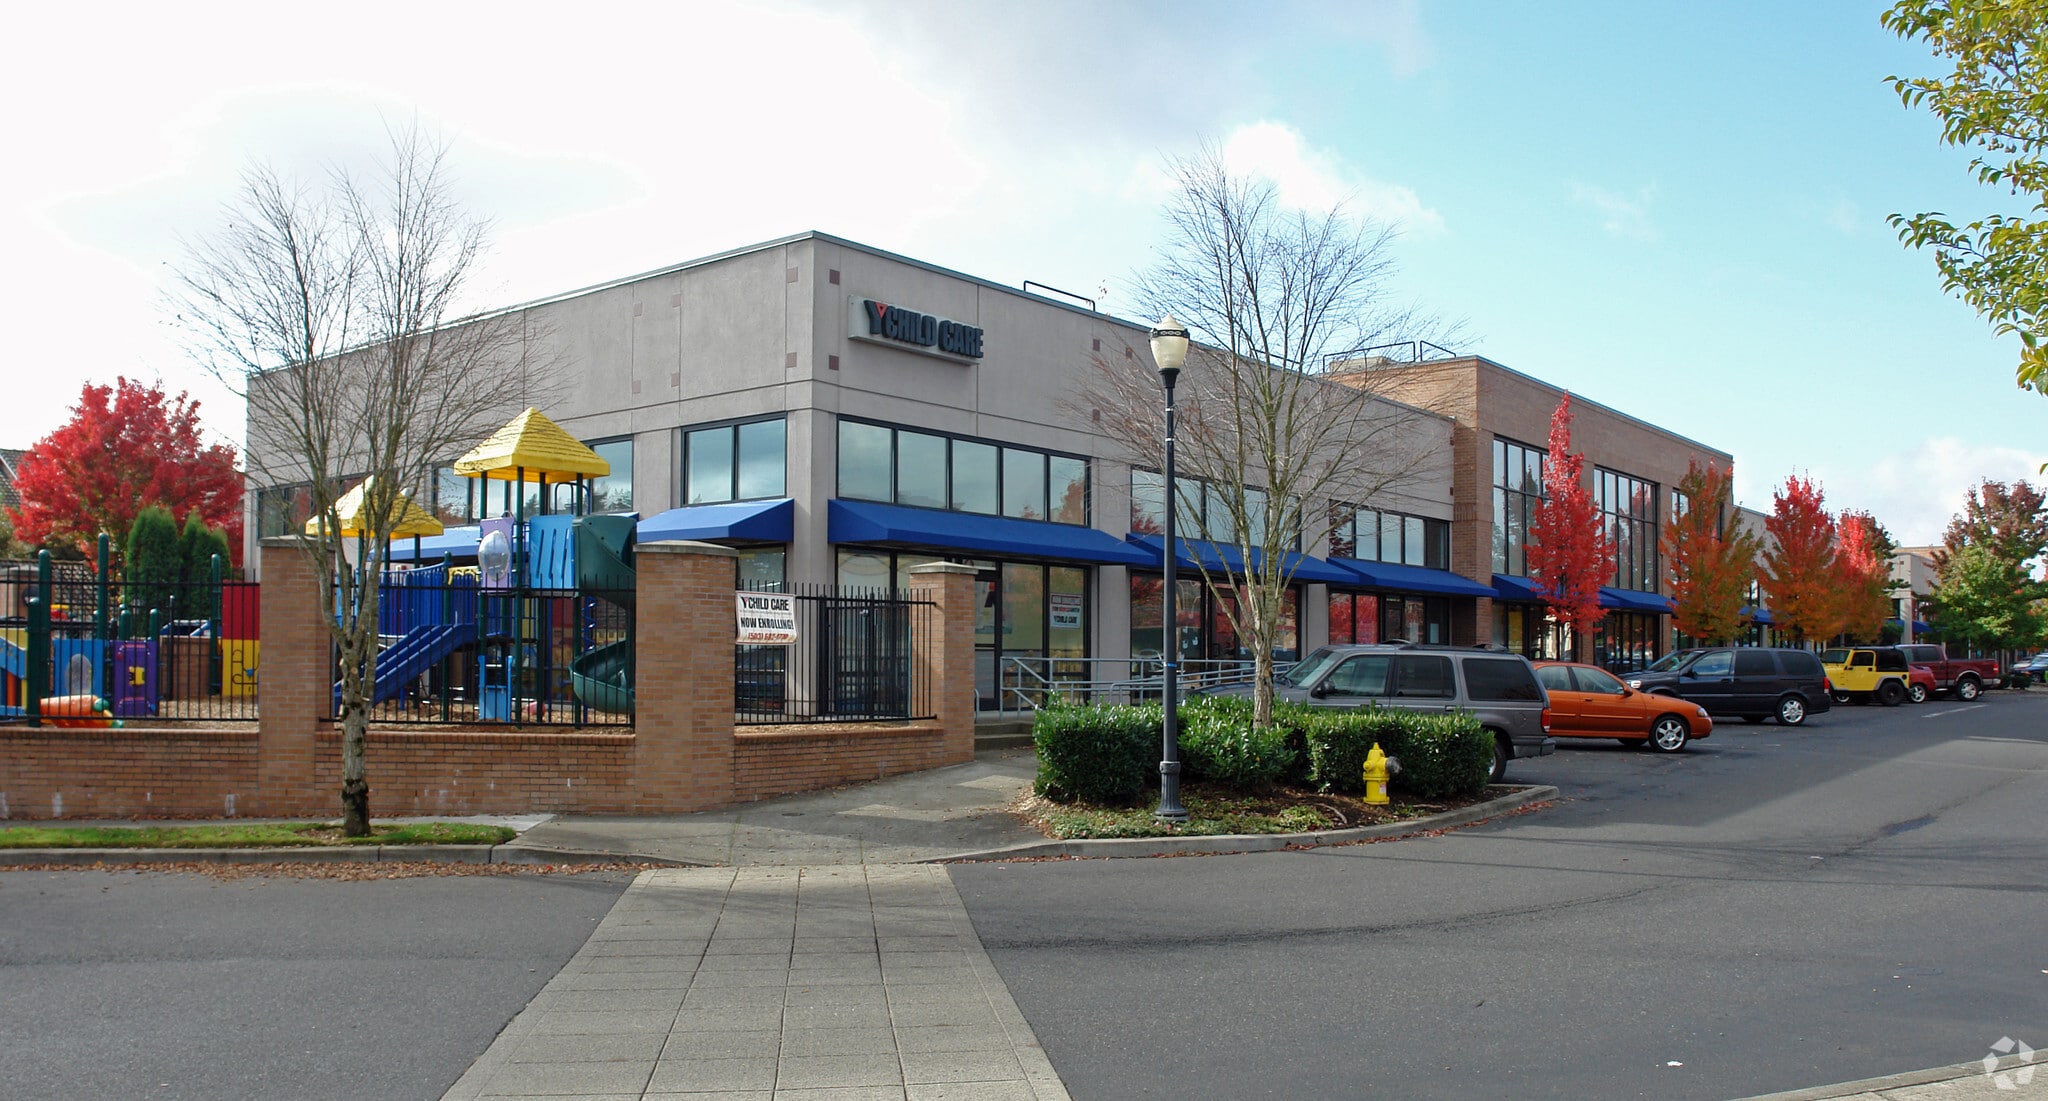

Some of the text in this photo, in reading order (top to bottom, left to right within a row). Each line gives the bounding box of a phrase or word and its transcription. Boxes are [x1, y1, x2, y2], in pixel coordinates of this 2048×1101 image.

[881, 305, 937, 347] CHILD
[938, 320, 984, 358] CARE
[748, 597, 769, 610] CHILD
[770, 598, 789, 611] CARE
[740, 617, 795, 630] NOW ENROLLING!
